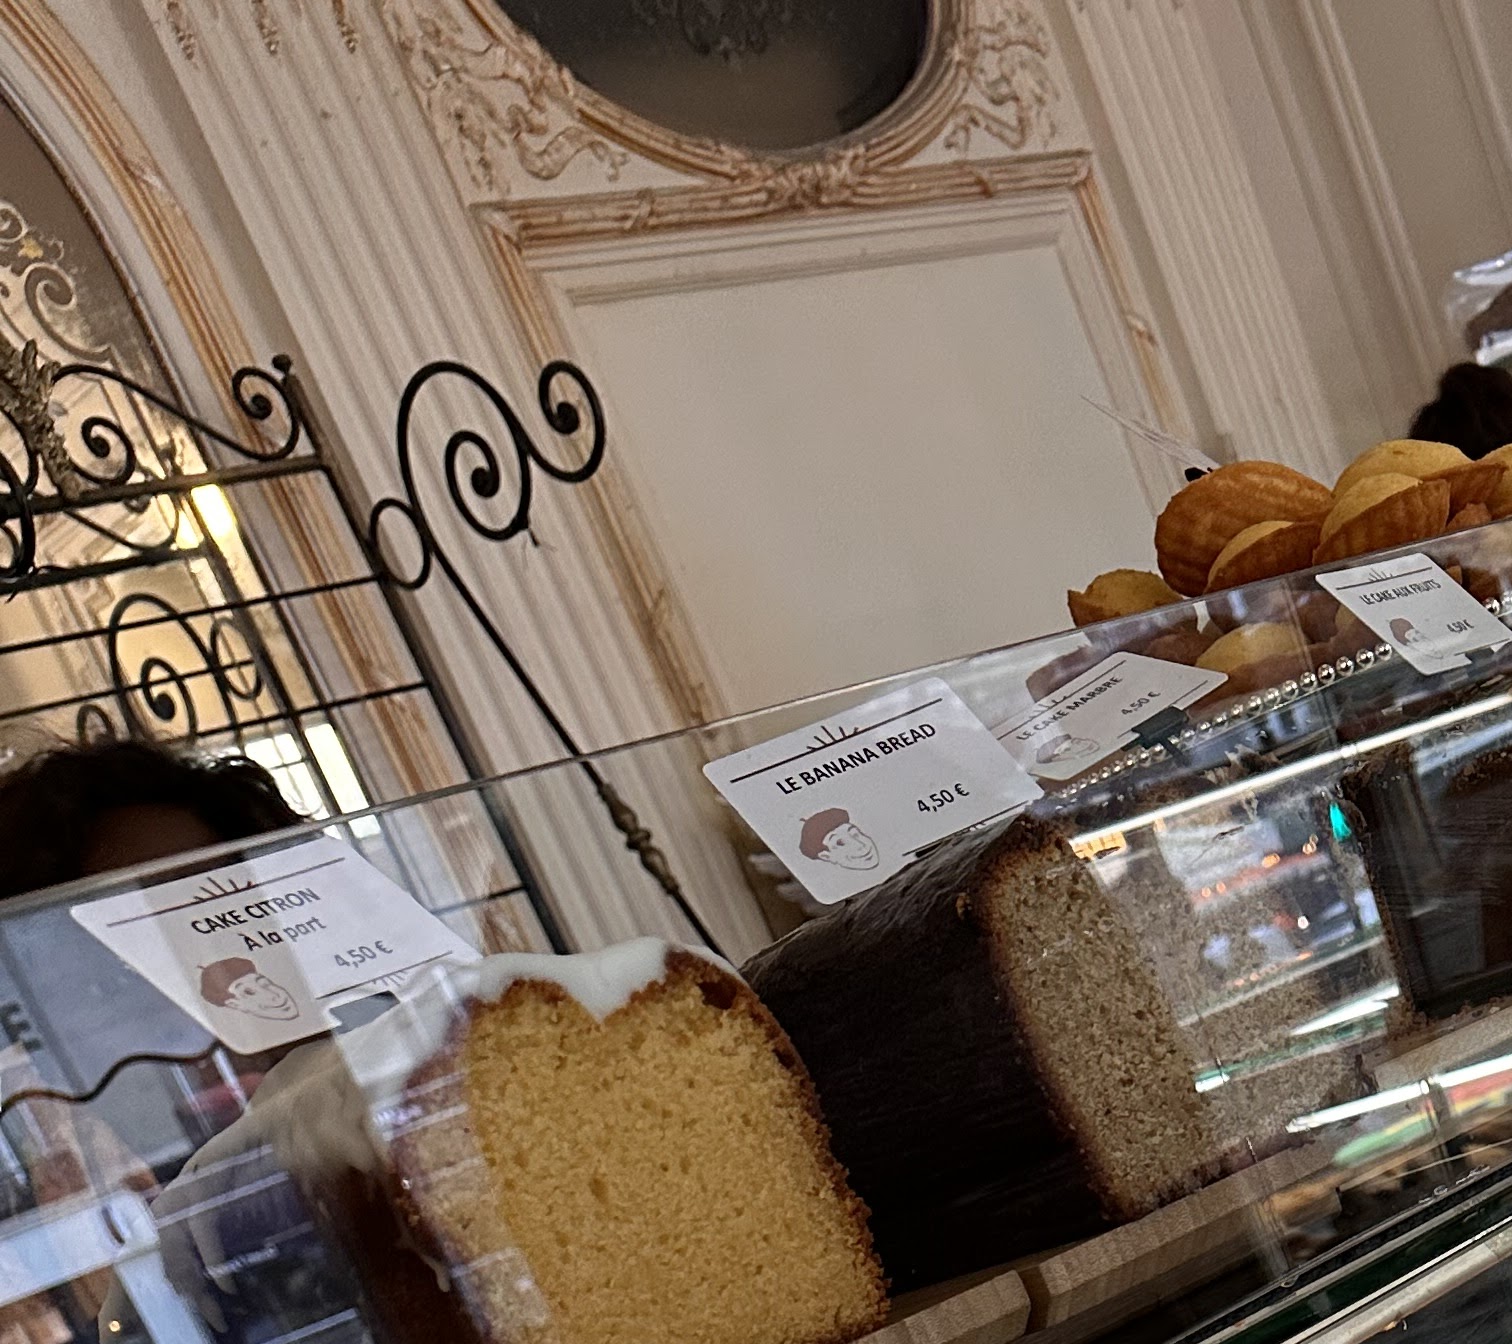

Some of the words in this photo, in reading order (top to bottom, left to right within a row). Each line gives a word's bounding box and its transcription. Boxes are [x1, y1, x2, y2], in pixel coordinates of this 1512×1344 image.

[1359, 594, 1375, 605] LE
[1371, 589, 1396, 602] CAKE
[1409, 579, 1441, 594] FRUITS
[1016, 731, 1034, 741] LE
[1033, 709, 1069, 731] CAKE
[776, 776, 802, 795] LE
[799, 747, 880, 786] BANANA
[876, 723, 936, 755] BREAD
[916, 789, 955, 813] 4,50
[954, 783, 970, 797] €
[190, 909, 247, 935] CAKE
[244, 887, 321, 919] CITRON
[237, 932, 263, 951] À
[257, 929, 285, 946] la
[283, 916, 327, 943] part
[333, 945, 377, 968] 4,50
[375, 940, 394, 955] €
